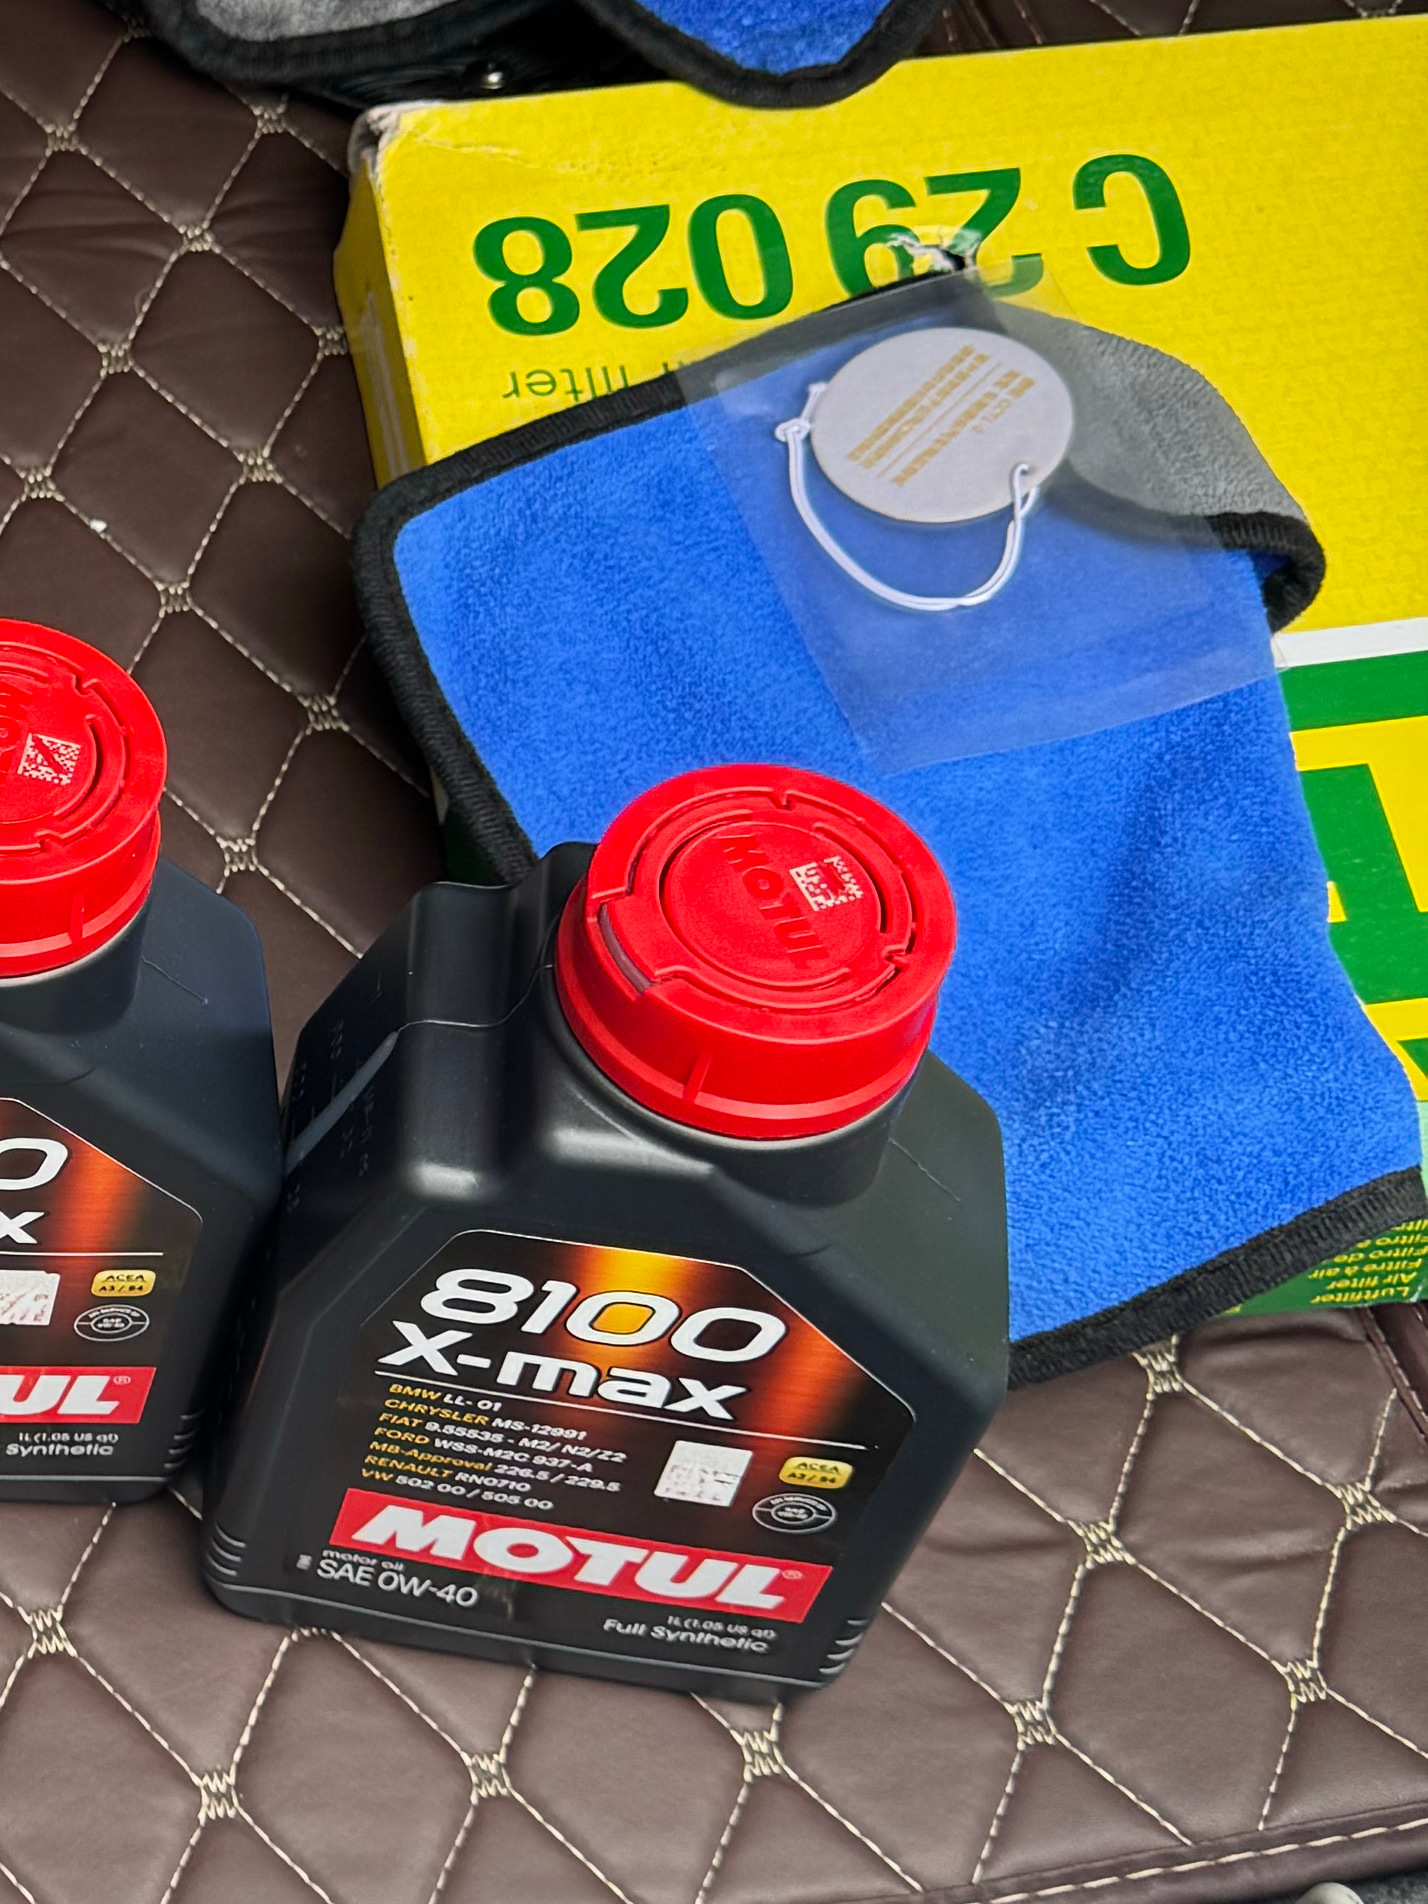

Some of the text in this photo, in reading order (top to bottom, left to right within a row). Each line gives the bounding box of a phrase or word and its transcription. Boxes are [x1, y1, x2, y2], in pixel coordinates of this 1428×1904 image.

[1072, 152, 1191, 287] C
[472, 191, 795, 336] 028
[1311, 1286, 1410, 1304] Luftfilter
[1326, 1272, 1418, 1290] Air filter
[420, 1268, 787, 1362] 8100
[377, 1320, 747, 1420] X-max
[389, 1383, 441, 1401] BMW
[378, 1412, 423, 1429] FIAT
[384, 1399, 489, 1425] CHRYSLER
[5, 1443, 114, 1457] Synthetic
[373, 1427, 430, 1445] FORD
[369, 1441, 493, 1471] MB-Approval
[361, 1469, 394, 1483] VW
[364, 1454, 532, 1493] RENAULT RN0710
[322, 1549, 378, 1569] motor
[381, 1560, 404, 1573] oil
[352, 1504, 788, 1610] MOTUL
[316, 1558, 375, 1587] SAE
[377, 1569, 478, 1608] 0W-40
[603, 1618, 769, 1654] Full Synthetic
